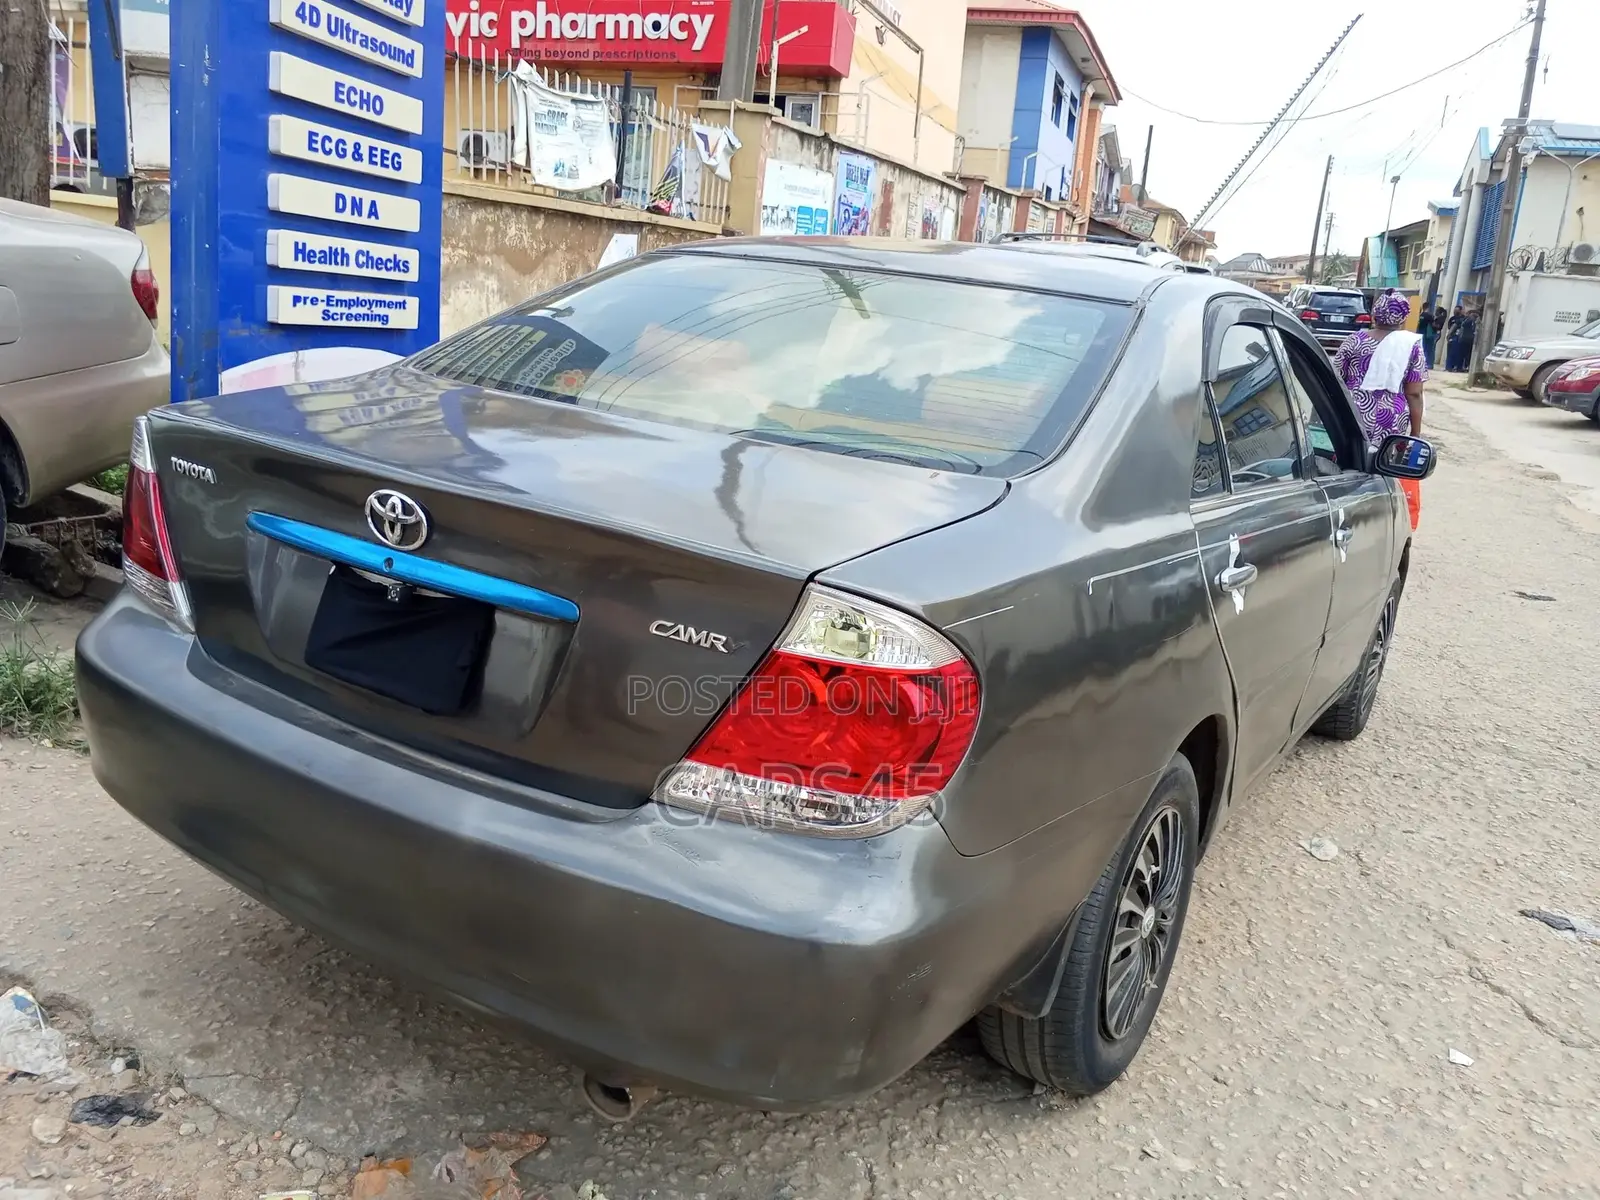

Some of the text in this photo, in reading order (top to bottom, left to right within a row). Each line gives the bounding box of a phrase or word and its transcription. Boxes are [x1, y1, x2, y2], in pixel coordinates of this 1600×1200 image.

[295, 2, 415, 69] 4D Ultrasound
[511, 1, 715, 50] pharmacy
[544, 48, 590, 60] beyond
[592, 49, 677, 61] prescriptions
[334, 81, 384, 116] ECHO
[308, 130, 402, 171] ECG & EEG
[293, 241, 410, 274] Health Checks
[321, 309, 389, 325] Screening
[171, 456, 215, 484] TOYOTA
